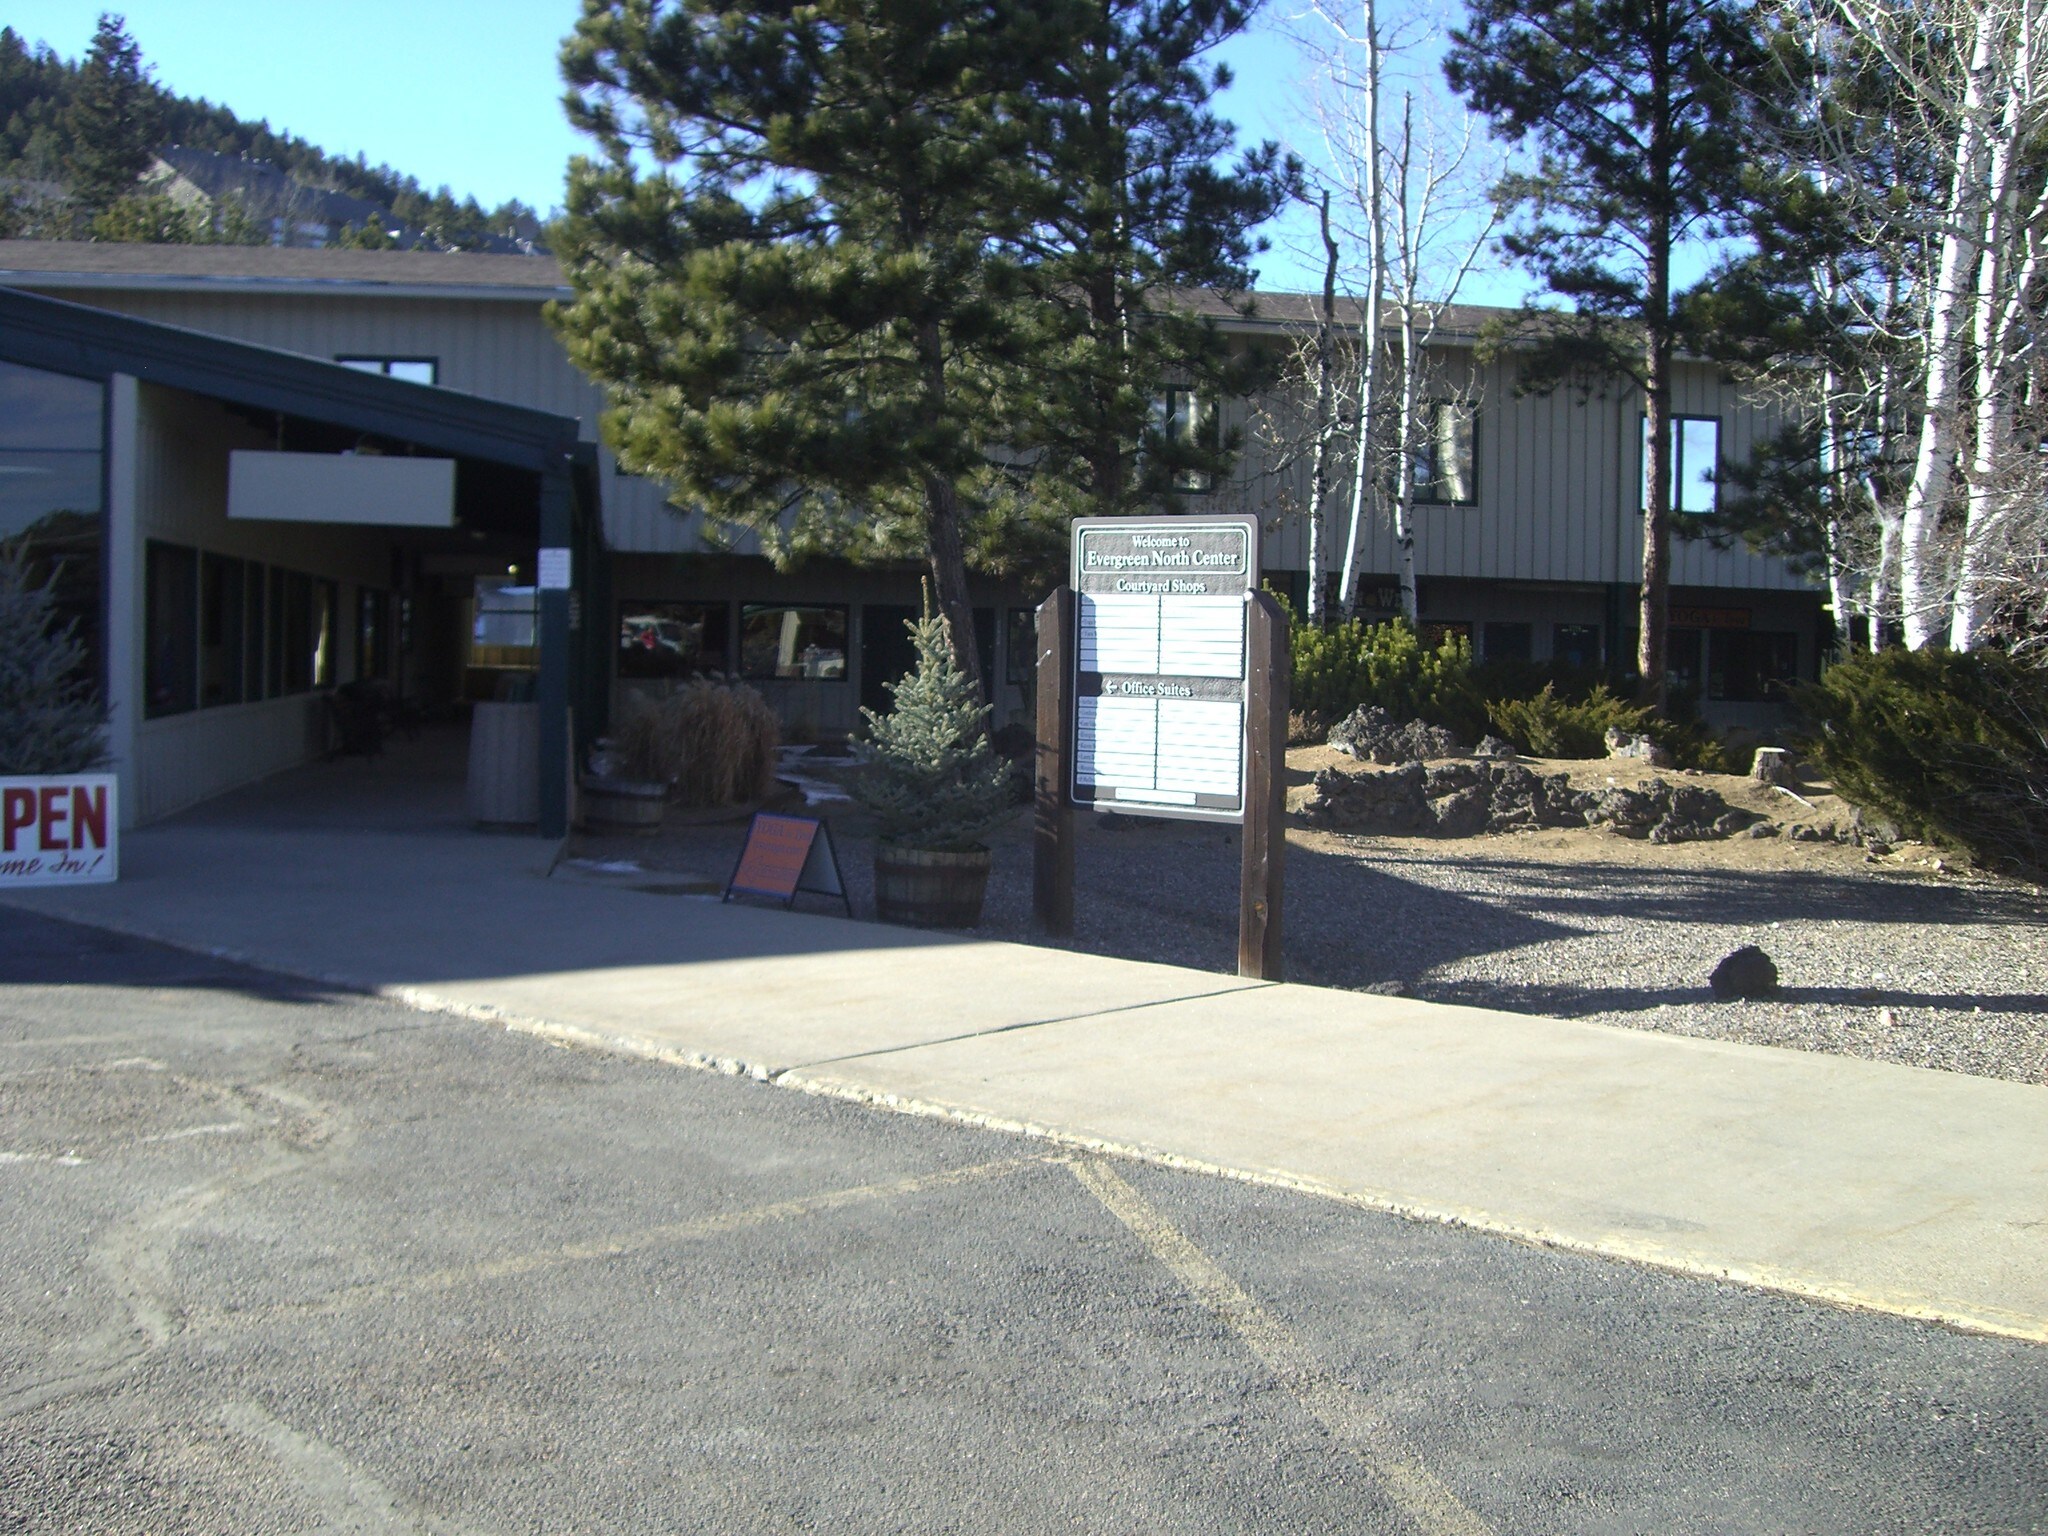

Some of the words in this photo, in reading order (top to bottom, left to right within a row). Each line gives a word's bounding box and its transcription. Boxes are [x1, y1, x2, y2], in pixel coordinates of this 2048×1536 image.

[1132, 535, 1177, 548] Welcome
[1179, 536, 1191, 547] to
[1087, 550, 1150, 569] Evergreen
[1151, 550, 1190, 566] North
[1192, 549, 1238, 566] Center
[1116, 578, 1170, 593] Courtyard
[1171, 579, 1206, 594] Shops
[1121, 681, 1155, 695] Office
[1157, 682, 1192, 697] Suites
[0, 786, 107, 852] PEN
